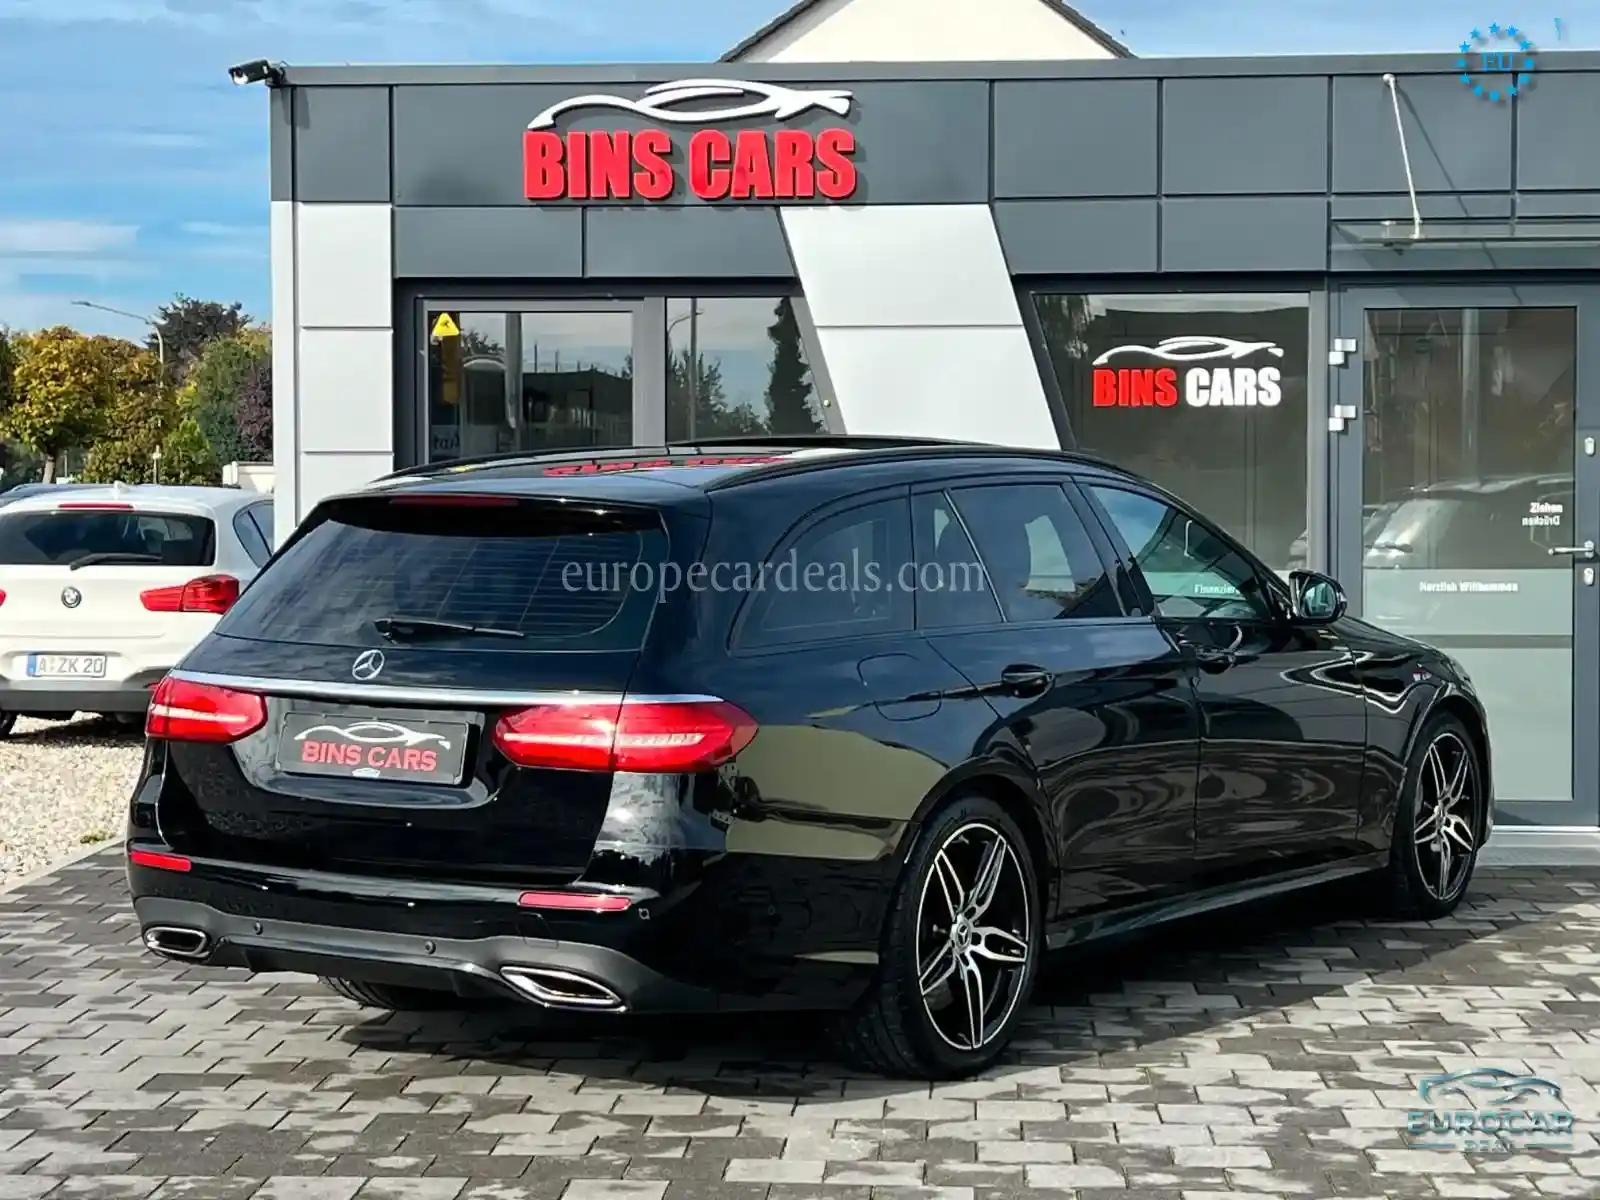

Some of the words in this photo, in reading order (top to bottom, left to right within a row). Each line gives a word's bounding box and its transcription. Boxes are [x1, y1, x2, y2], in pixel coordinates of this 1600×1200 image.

[523, 130, 674, 200] BINS
[689, 129, 857, 200] CARS
[1093, 368, 1178, 407] BINS
[1185, 367, 1282, 407] CARS
[1419, 582, 1458, 592] Herzlich
[1460, 582, 1518, 592] Willkommen
[57, 657, 79, 673] ZK
[83, 658, 104, 673] 20
[302, 741, 362, 766] BINS
[367, 746, 437, 772] CARS
